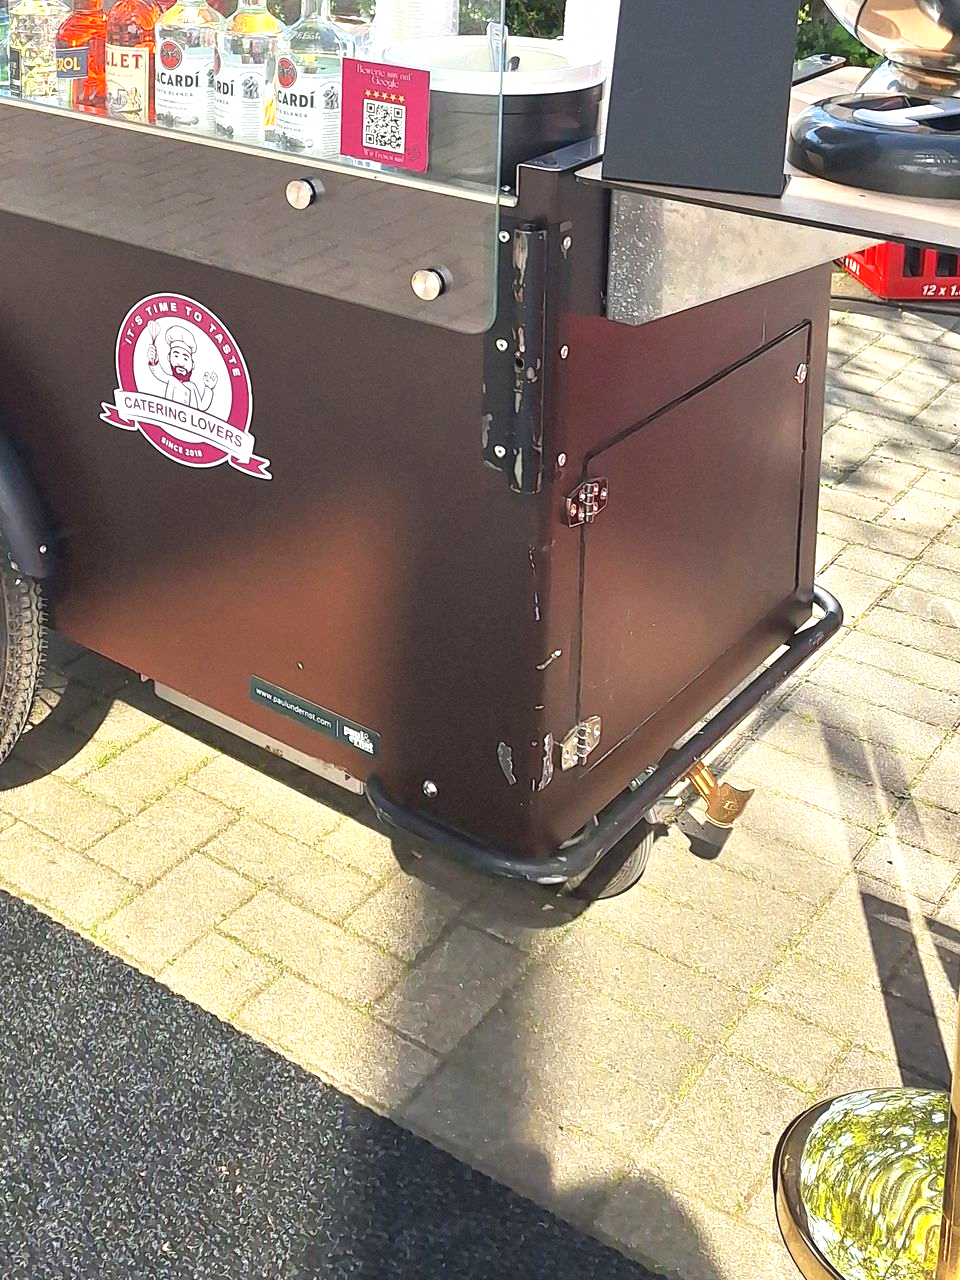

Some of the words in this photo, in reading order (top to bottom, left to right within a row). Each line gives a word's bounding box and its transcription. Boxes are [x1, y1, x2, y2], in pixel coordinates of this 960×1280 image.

[371, 75, 399, 89] Google
[923, 285, 937, 296] 12
[938, 286, 947, 296] x
[951, 285, 960, 296] 1.
[124, 315, 143, 345] IT'S
[145, 302, 178, 316] TIME
[185, 306, 202, 322] TO
[209, 323, 241, 377] TASTE
[124, 396, 187, 423] CATERING
[190, 414, 243, 448] LOVERS
[160, 436, 184, 455] SINCE
[184, 446, 203, 458] 2018
